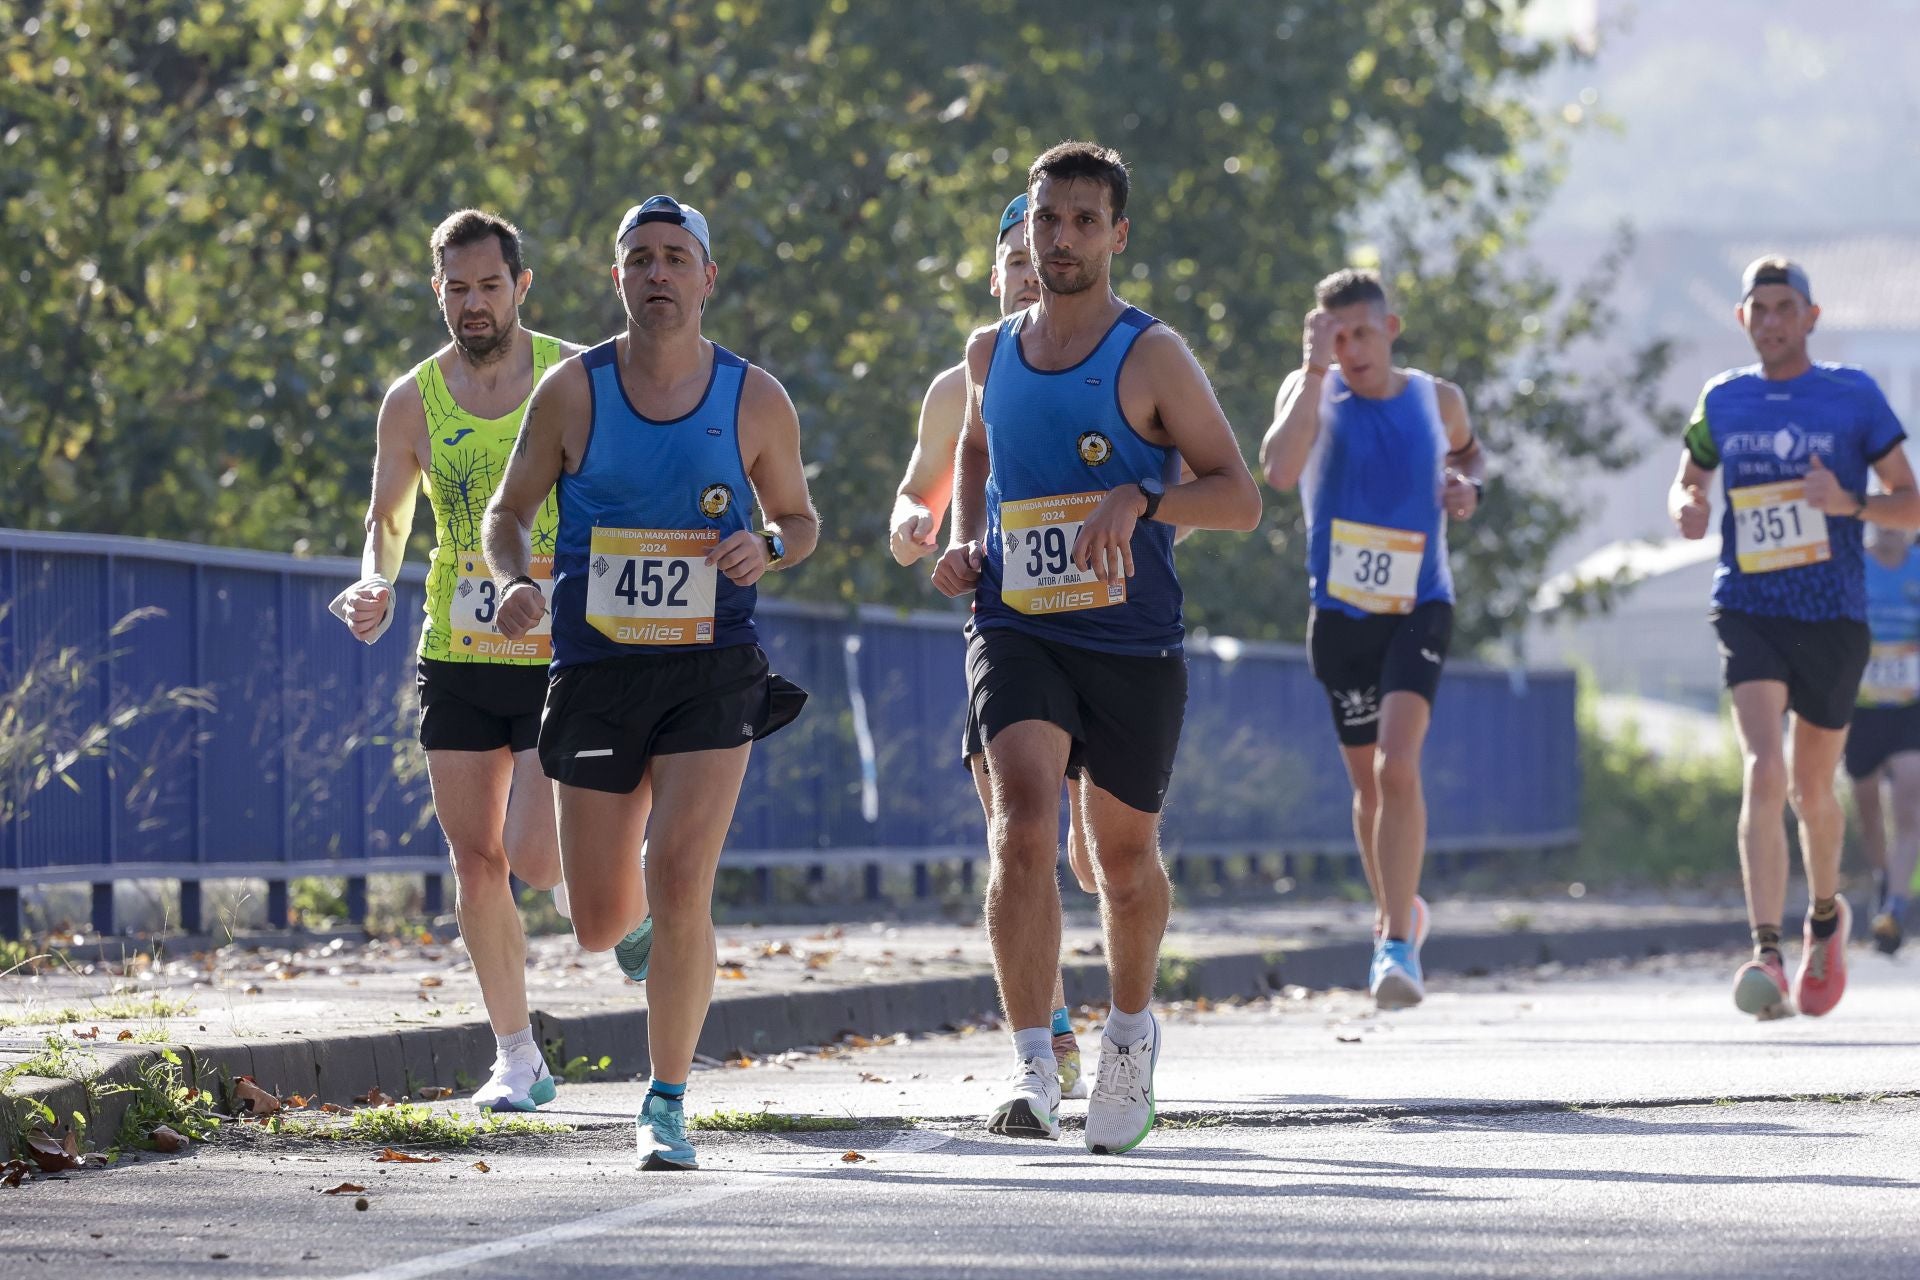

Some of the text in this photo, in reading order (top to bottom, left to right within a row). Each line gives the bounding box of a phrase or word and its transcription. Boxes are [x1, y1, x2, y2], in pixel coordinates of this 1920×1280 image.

[1020, 502, 1044, 512] MEDIA
[1043, 496, 1083, 508] MARATÓN
[1041, 511, 1066, 521] 2024
[1750, 504, 1803, 543] 351
[617, 530, 642, 539] MEDIA
[644, 531, 688, 540] MARATÓN
[689, 531, 717, 540] AVILÉS
[639, 543, 668, 553] 2024
[1355, 549, 1392, 586] 38
[614, 559, 690, 607] 452
[1038, 576, 1057, 587] AITOR
[1063, 574, 1082, 584] IRAIA
[1031, 591, 1094, 610] avilés
[616, 624, 684, 641] avilés
[477, 639, 539, 656] avilés
